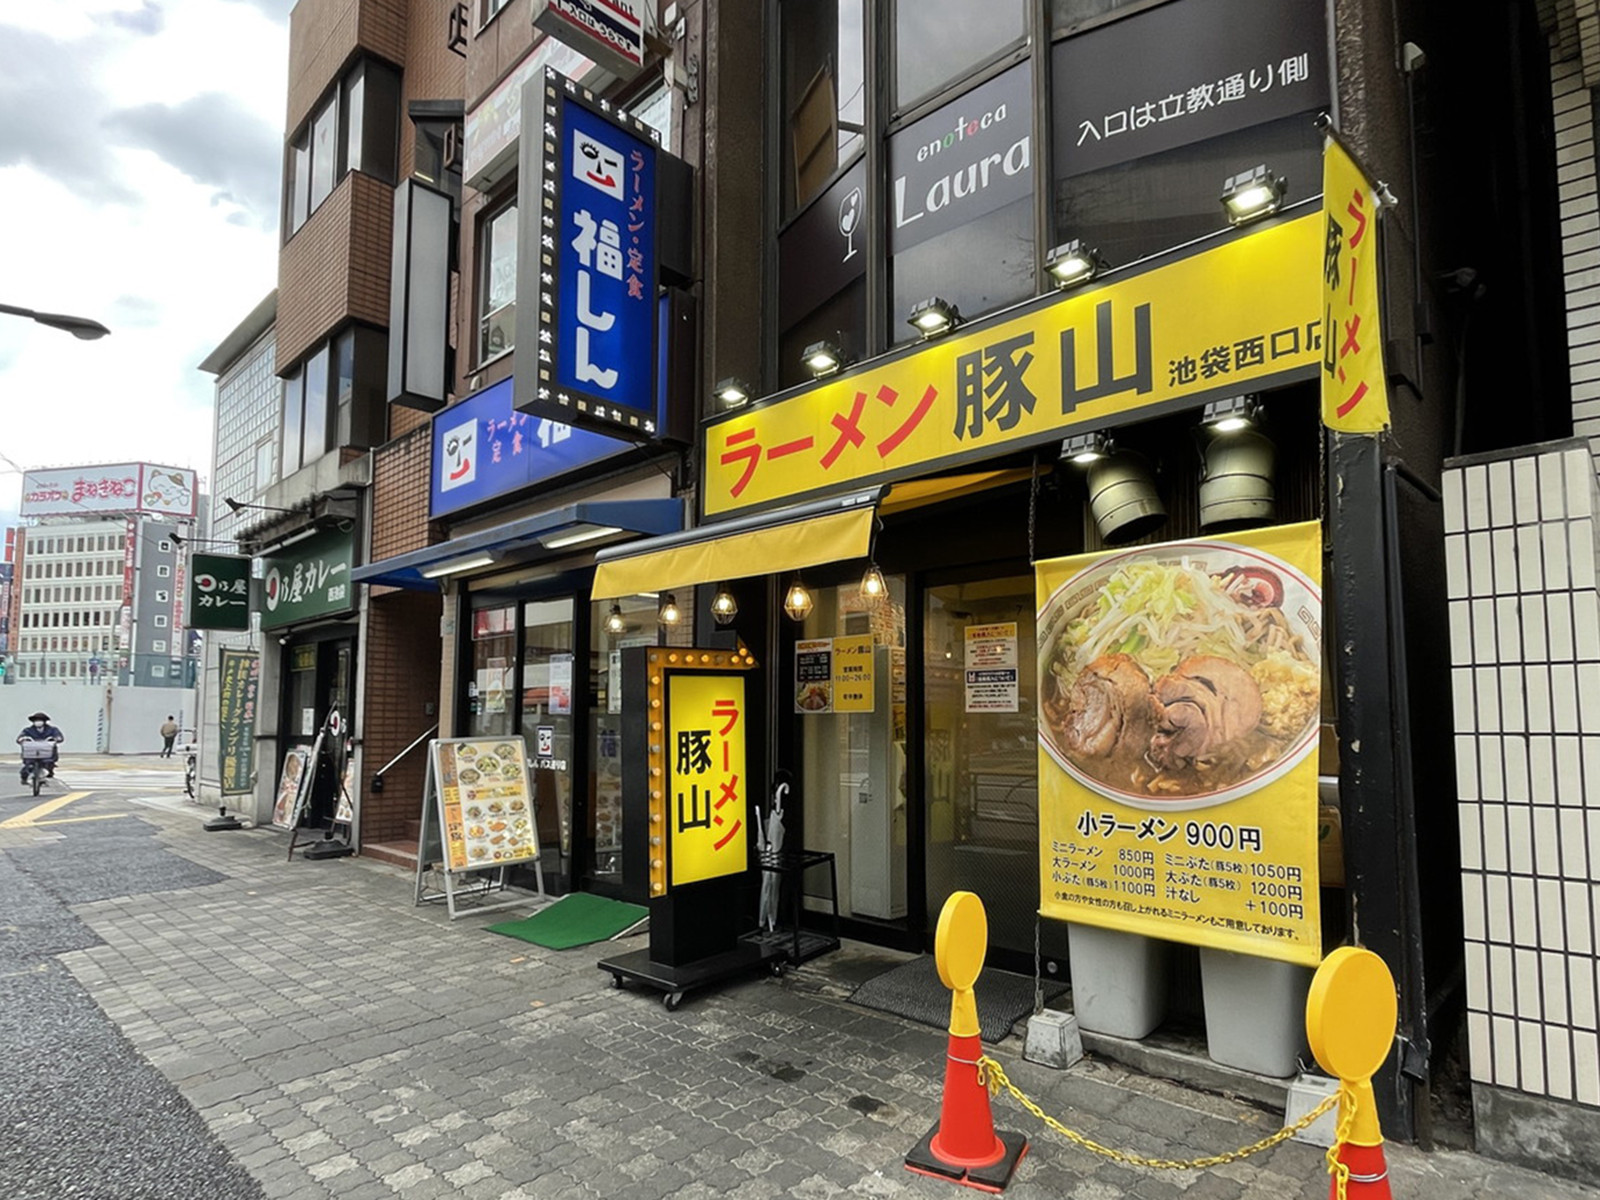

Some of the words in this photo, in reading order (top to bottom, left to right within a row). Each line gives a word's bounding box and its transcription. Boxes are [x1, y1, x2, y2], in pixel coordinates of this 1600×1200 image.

[1076, 53, 1309, 147] 入口は立教通り側
[916, 103, 1008, 162] enoteca
[894, 135, 1031, 229] Laura
[571, 209, 623, 389] 福しん
[1336, 187, 1370, 419] ラーメン
[71, 476, 136, 504] まねきねこ
[198, 595, 247, 608] カレー
[676, 730, 712, 834] 豚山
[711, 700, 742, 851] ラーメン
[1077, 811, 1179, 842] 小ラーメン
[1185, 821, 1263, 852] 900円
[1052, 841, 1104, 858] ミニラーメン
[1118, 848, 1154, 865] 850円
[1052, 856, 1097, 872] 大ラーメン
[1113, 864, 1155, 881] 1000円
[1113, 880, 1156, 897] 1100円
[1250, 863, 1302, 883] 1050円
[1165, 886, 1201, 903] 汁なし
[1251, 881, 1303, 901] 1200円
